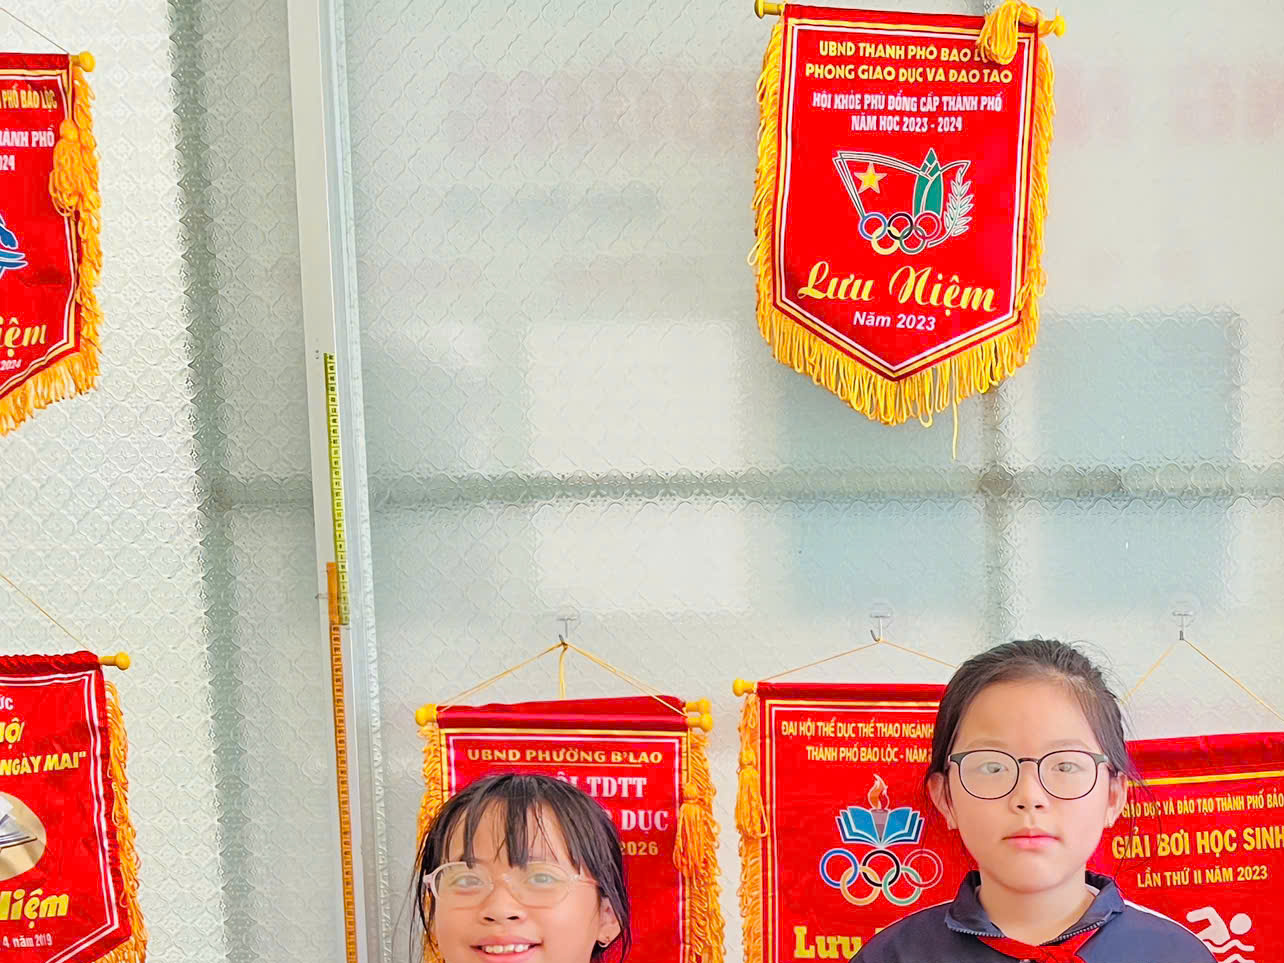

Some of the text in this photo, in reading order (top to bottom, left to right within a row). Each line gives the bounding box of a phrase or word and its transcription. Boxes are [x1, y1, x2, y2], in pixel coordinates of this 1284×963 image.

[819, 40, 855, 56] UBND
[812, 90, 832, 111] HỘI
[851, 112, 963, 134] NĂM HỌC 2023 2024
[797, 261, 997, 317] Lưu Niệm
[853, 311, 937, 331] Năm 2023
[781, 721, 798, 740] ĐẠI
[799, 718, 815, 740] HỘI
[876, 723, 900, 738] THAO
[467, 749, 520, 761] UBND
[525, 747, 605, 763] PHƯỜNG
[881, 745, 898, 765] LỘC
[587, 776, 647, 798] TDTT
[1197, 798, 1215, 816] TẠO
[1246, 791, 1266, 809] PHỐ
[622, 810, 668, 835] DỤC
[1112, 826, 1151, 859] GIẢI
[1157, 829, 1190, 856] BƠI
[1196, 829, 1237, 857] HỌC
[1137, 865, 1268, 888] LẦN THỨ II NĂM 2023
